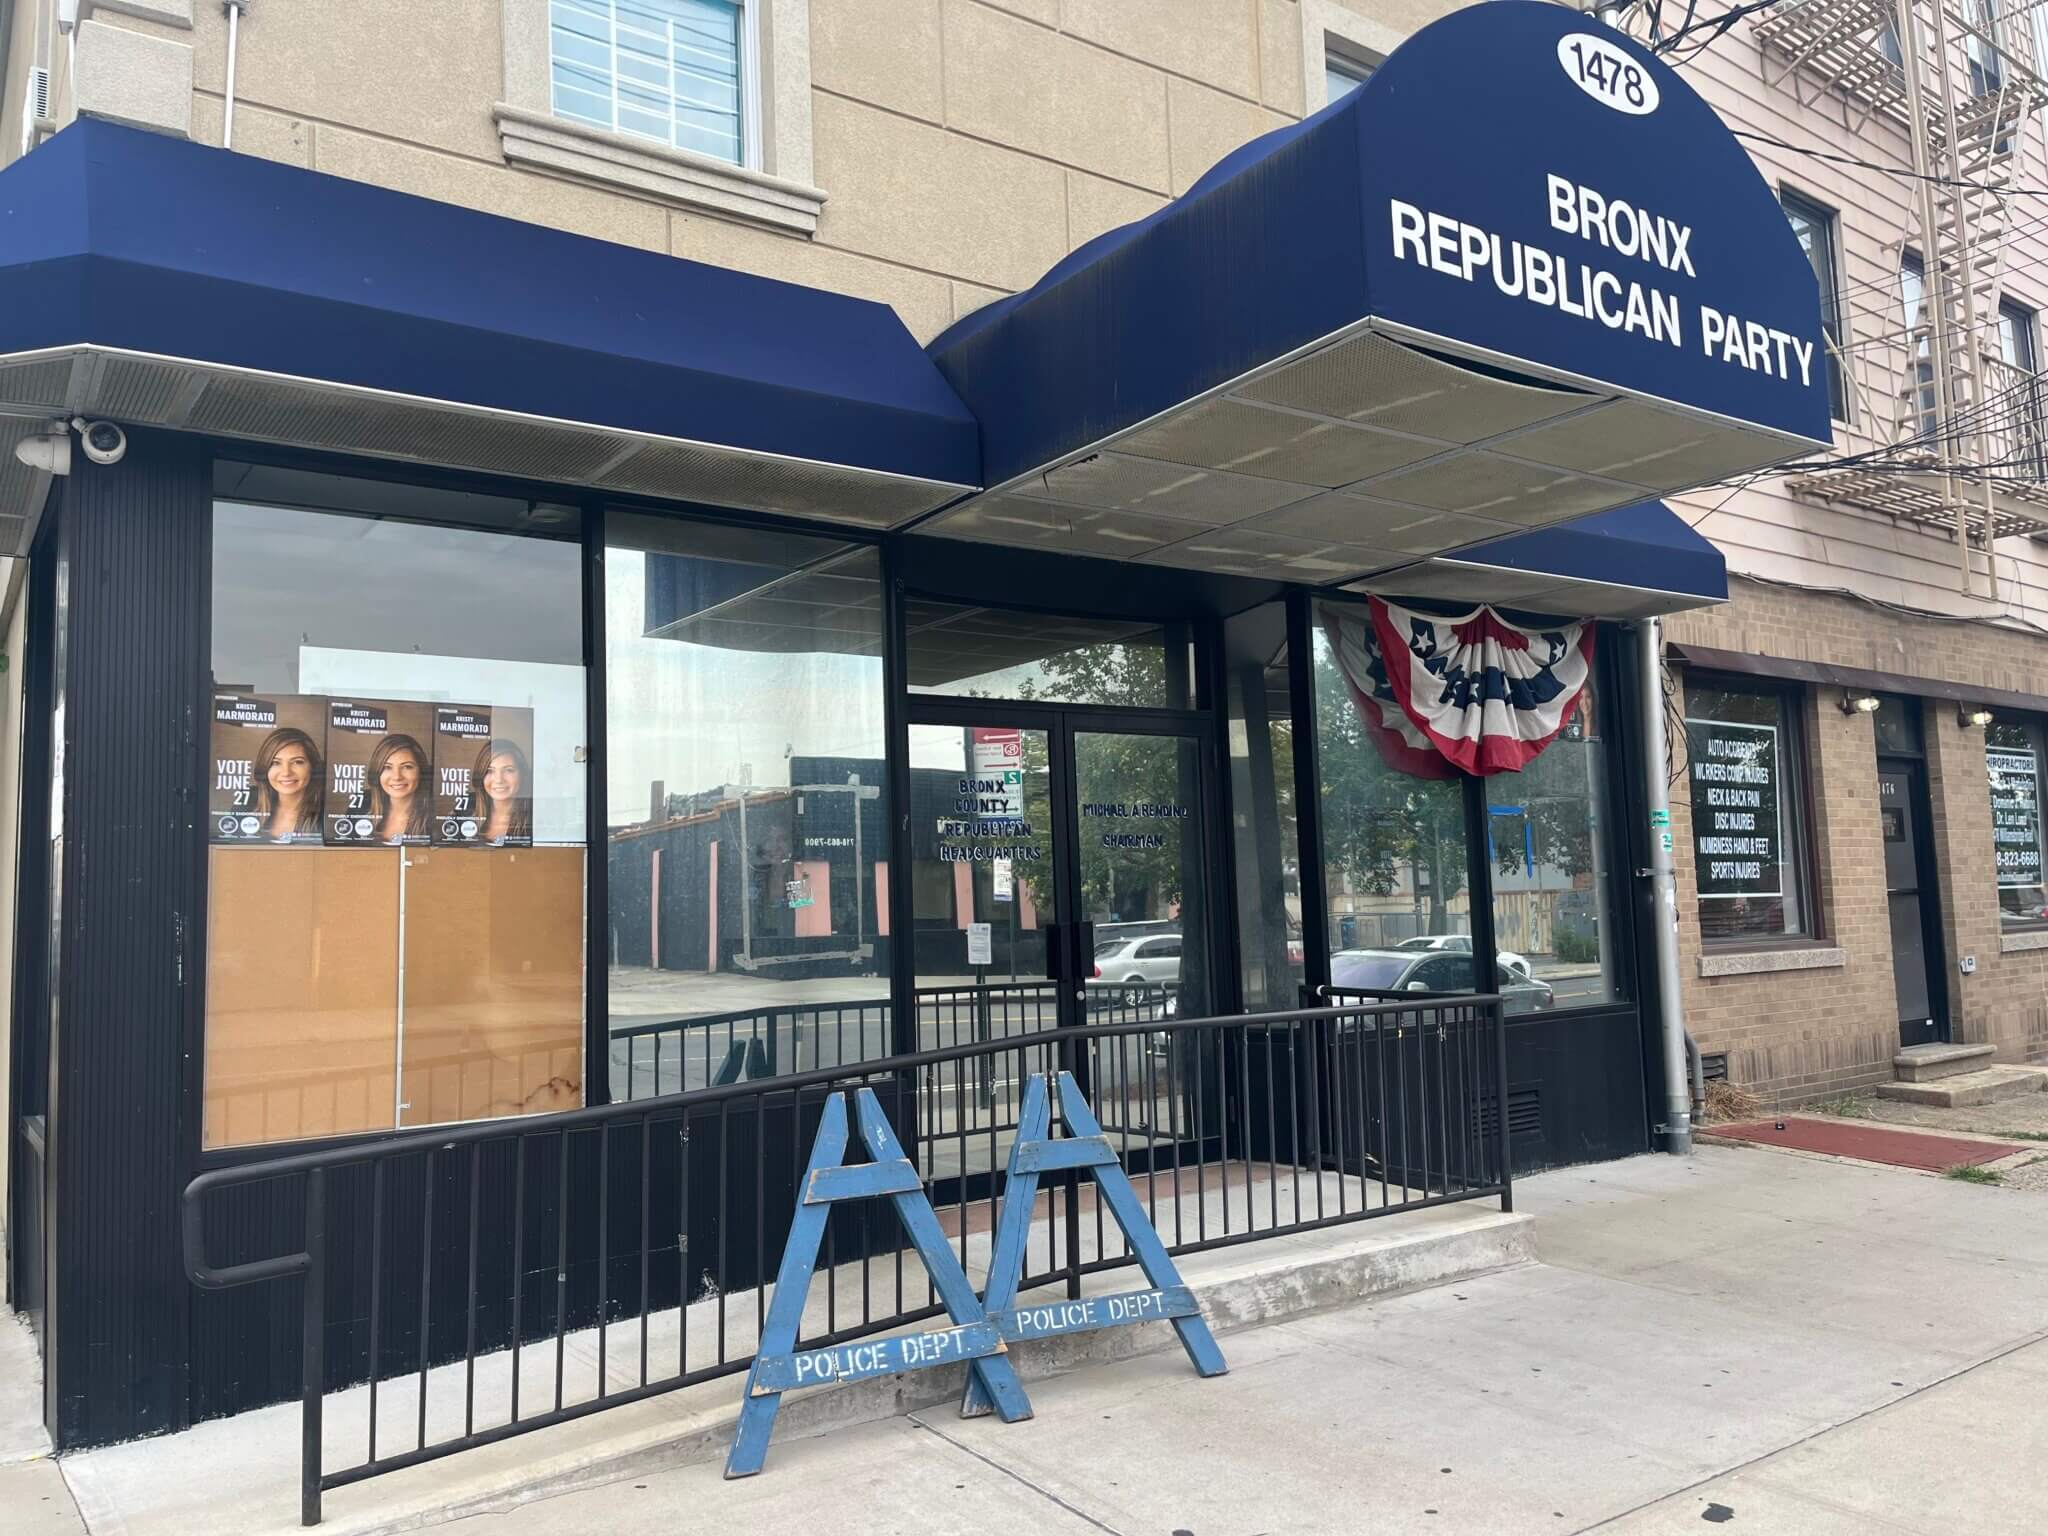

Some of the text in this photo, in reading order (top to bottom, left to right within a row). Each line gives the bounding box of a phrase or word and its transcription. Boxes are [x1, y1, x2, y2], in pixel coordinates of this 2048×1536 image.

[1570, 41, 1645, 107] 1478
[1547, 173, 1696, 278] BRONX
[1391, 199, 1814, 387] REPUBLICAN PARTY
[216, 710, 274, 722] MARMORATO
[350, 709, 369, 717] KRISTY
[333, 716, 386, 728] MARMORATO
[440, 722, 488, 733] MARMORATO
[1708, 738, 1724, 757] AUTO
[217, 759, 252, 775] VOTE
[334, 764, 366, 779] VOTE
[216, 775, 250, 790] JUNE
[440, 768, 470, 782] VOTE
[333, 779, 364, 794] JUNE
[440, 783, 469, 796] JUNE
[959, 779, 1006, 794] BRONX
[233, 791, 250, 806] 27
[349, 794, 364, 809] 27
[455, 797, 469, 810] 27
[1708, 788, 1760, 808] NECK & BACK PAIN
[954, 799, 1009, 813] COUNTY
[1083, 803, 1128, 818] MICHAEL
[1715, 812, 1755, 830] DISC INJURIES
[944, 822, 1032, 837] REPUBLICAN
[1103, 834, 1162, 849] CHAIRMAN
[1700, 837, 1769, 855] NUMBNESS HAND & FEET
[940, 845, 1041, 862] HEADQUARTERS
[1711, 861, 1760, 879] SPORTS INJURIES
[1016, 1301, 1098, 1334] POLICE
[795, 1341, 889, 1382] POLICE
